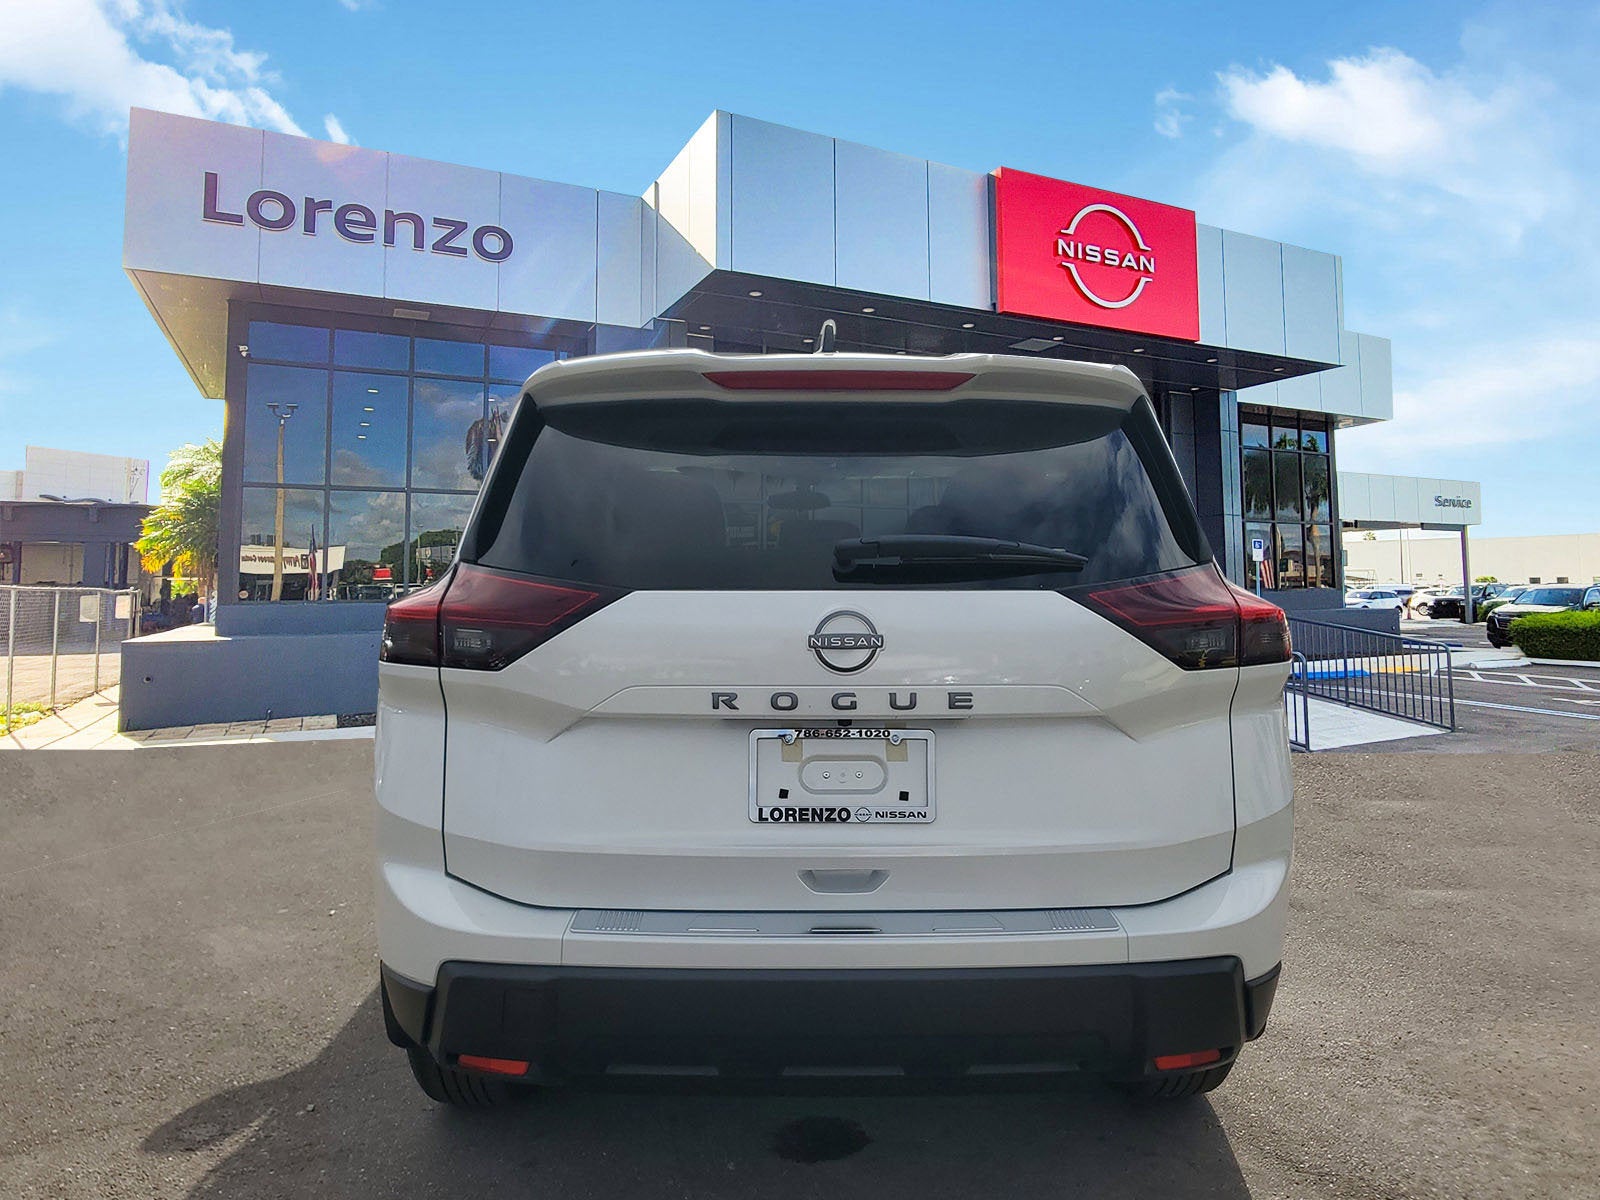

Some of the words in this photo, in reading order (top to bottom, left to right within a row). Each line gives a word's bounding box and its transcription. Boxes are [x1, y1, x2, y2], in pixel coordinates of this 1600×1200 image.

[203, 171, 514, 262] Lorenzo
[1057, 238, 1155, 274] NISSAN
[1434, 495, 1472, 509] Service
[810, 637, 882, 647] NISSAN
[711, 692, 975, 711] ROGUE
[794, 729, 891, 739] 786-652-1020
[757, 807, 852, 822] LORENZO
[874, 811, 928, 819] NISSAN
